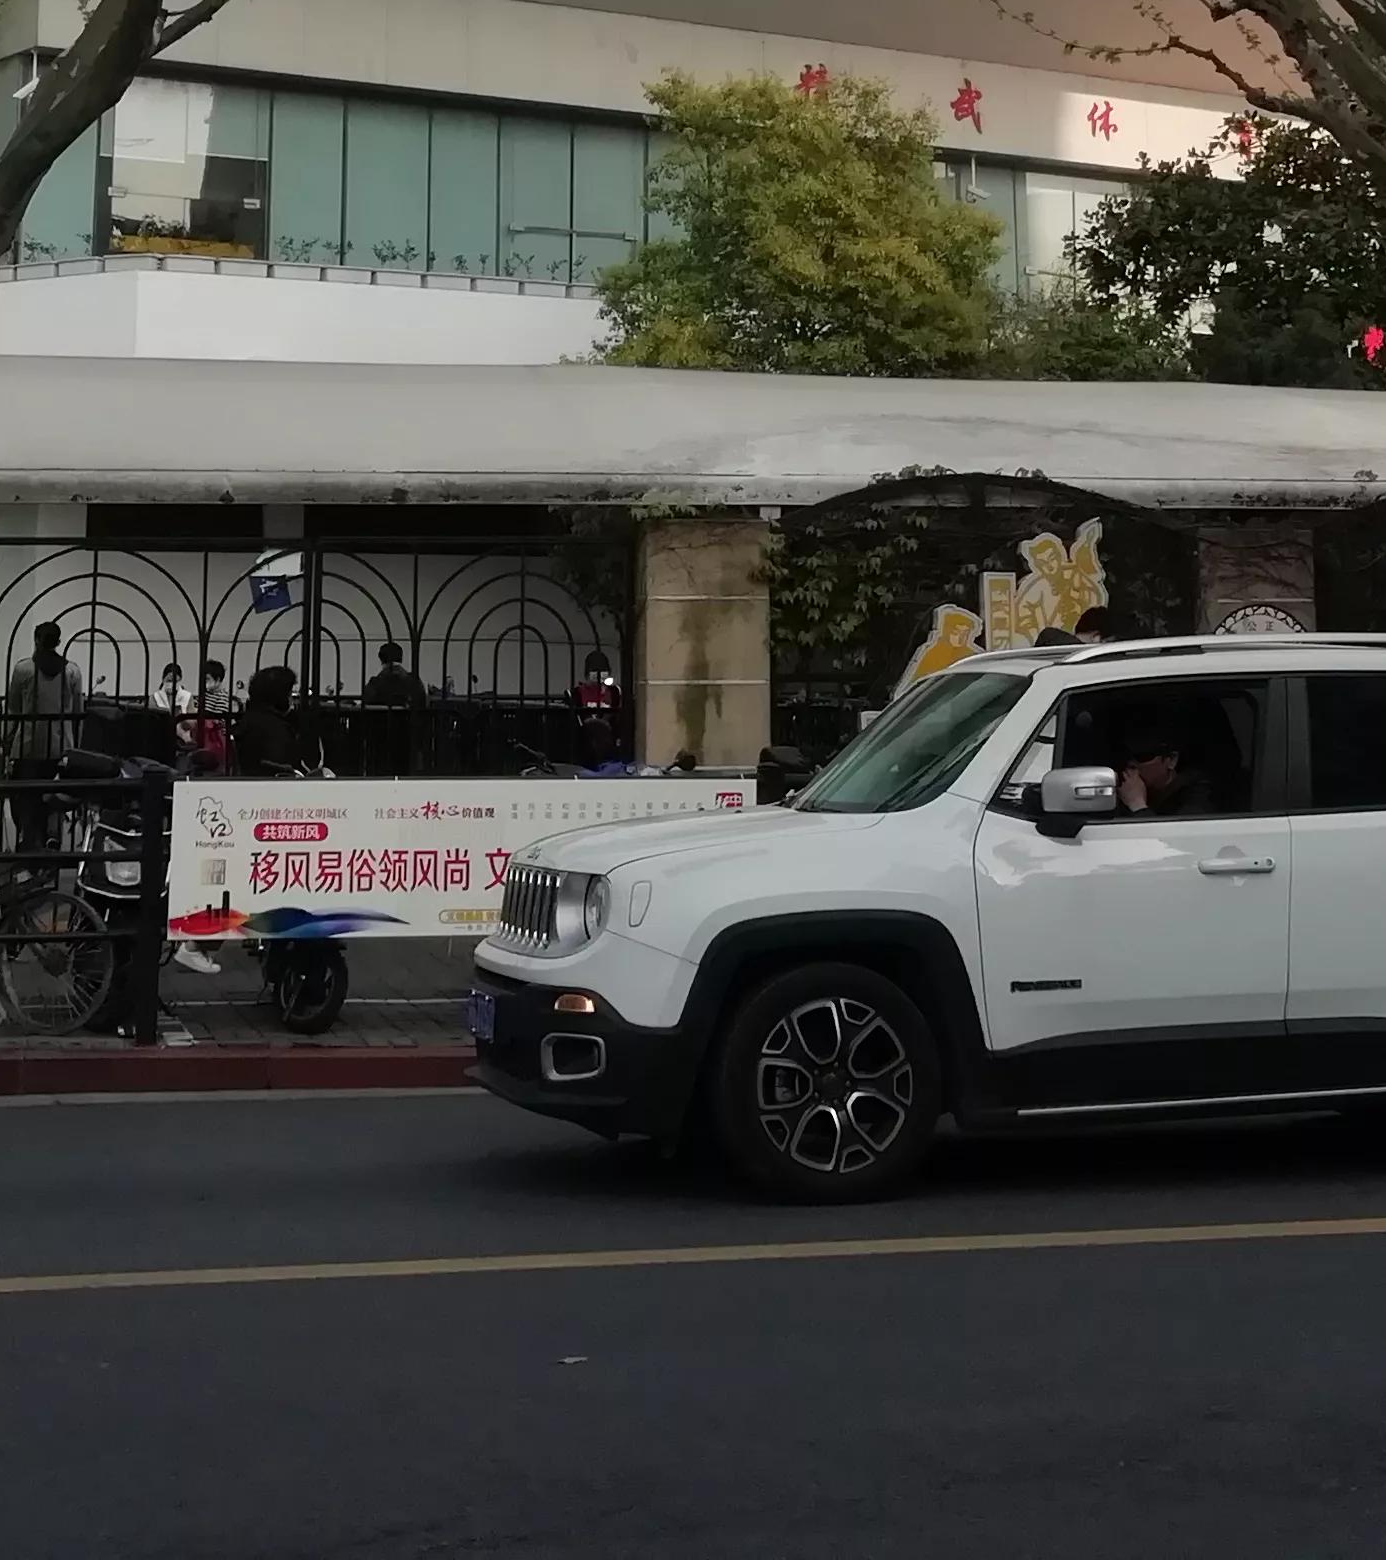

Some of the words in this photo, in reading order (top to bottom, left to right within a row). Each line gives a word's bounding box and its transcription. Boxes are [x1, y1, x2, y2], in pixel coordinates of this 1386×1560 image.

[237, 807, 350, 820] 全力创建全国文明城区
[374, 801, 496, 821] 社会主义核心价值观
[262, 824, 321, 840] 共筑新风
[249, 848, 470, 894] 移风易俗领风尚
